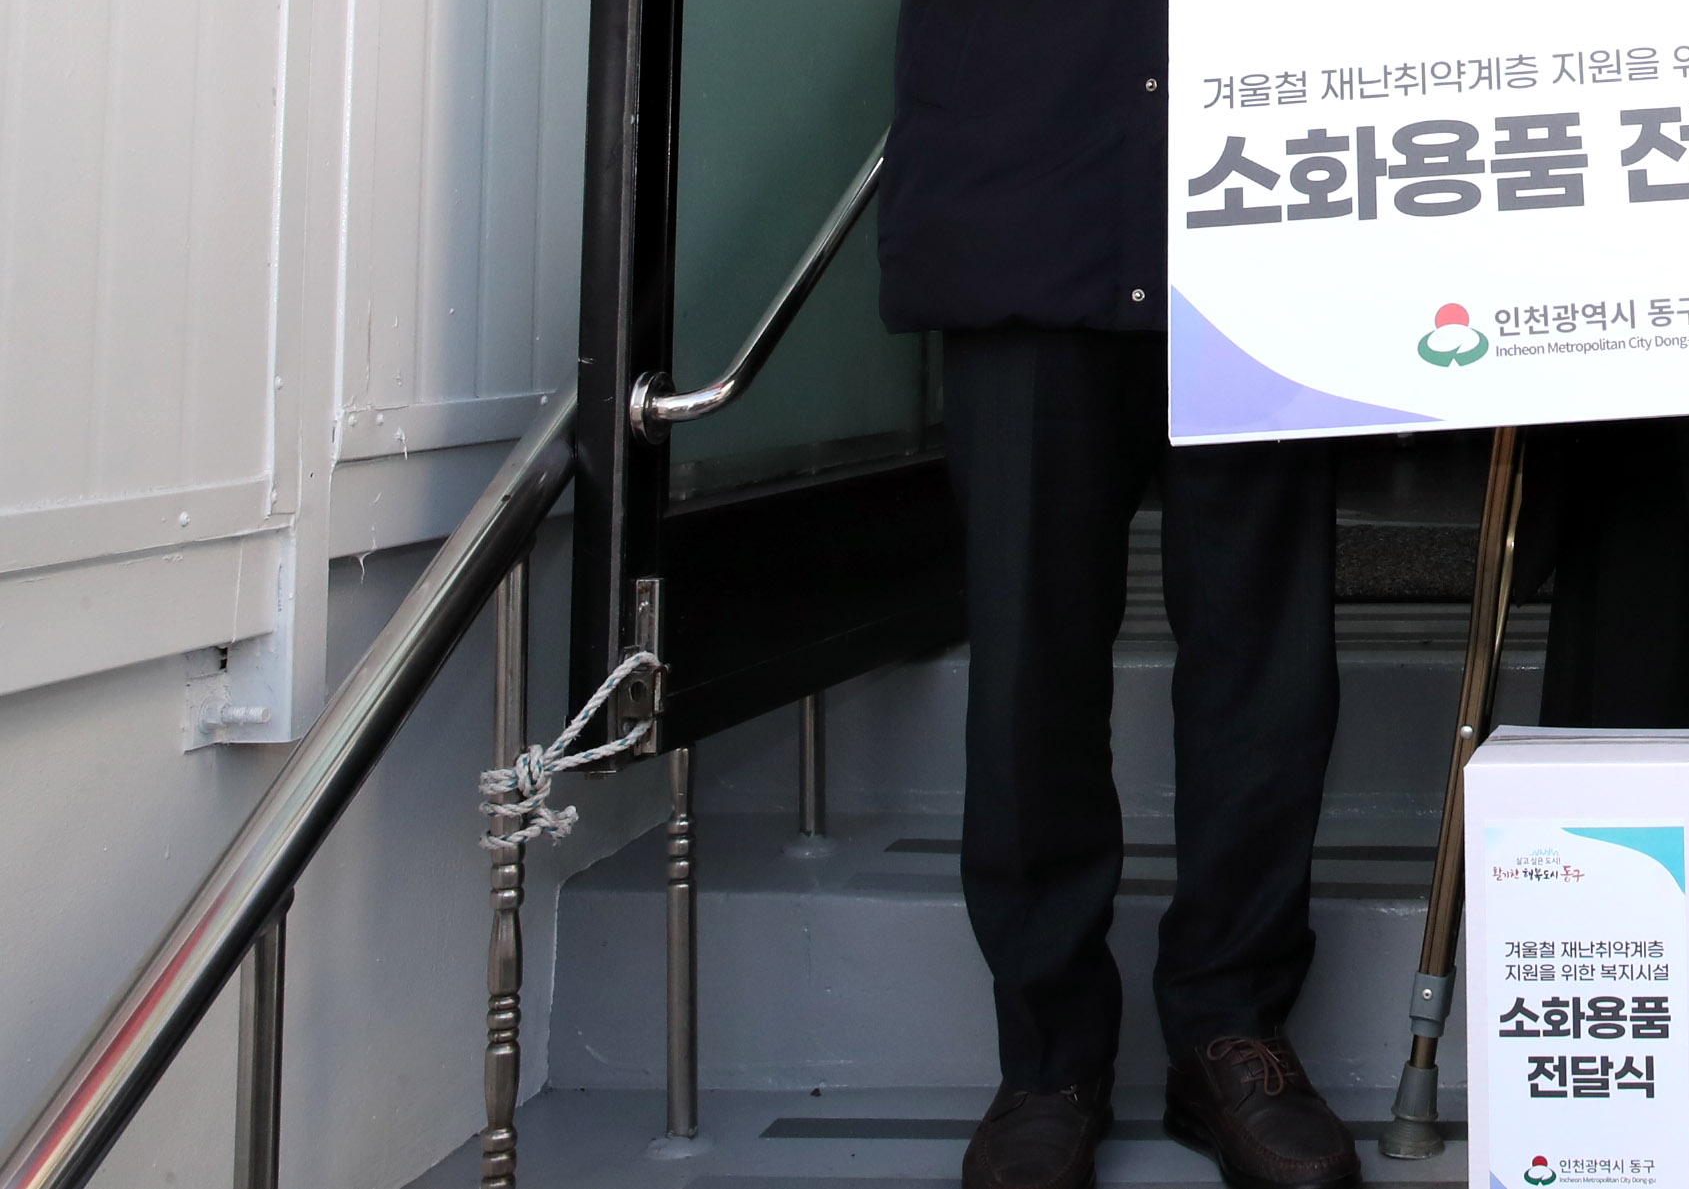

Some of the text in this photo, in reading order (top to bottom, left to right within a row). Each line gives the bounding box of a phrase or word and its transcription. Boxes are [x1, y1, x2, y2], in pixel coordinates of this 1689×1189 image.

[1203, 70, 1308, 110] 겨울철
[1320, 53, 1539, 101] 재난취약계층
[1551, 46, 1660, 85] 지원을
[1186, 112, 1589, 229] 소화용품
[1494, 299, 1636, 338] 인천광역시
[1495, 343, 1545, 357] Incheon
[1547, 337, 1626, 356] Metropolitan
[1628, 335, 1652, 351] City
[1560, 865, 1585, 883] 동구
[1505, 940, 1665, 959] 겨울철 재난취약계층
[1505, 963, 1670, 981] 지원을 위한 복지시설
[1499, 996, 1671, 1039] 소화용품
[1527, 1055, 1655, 1099] 전달식
[1559, 1158, 1656, 1174] 인천광역시 동구
